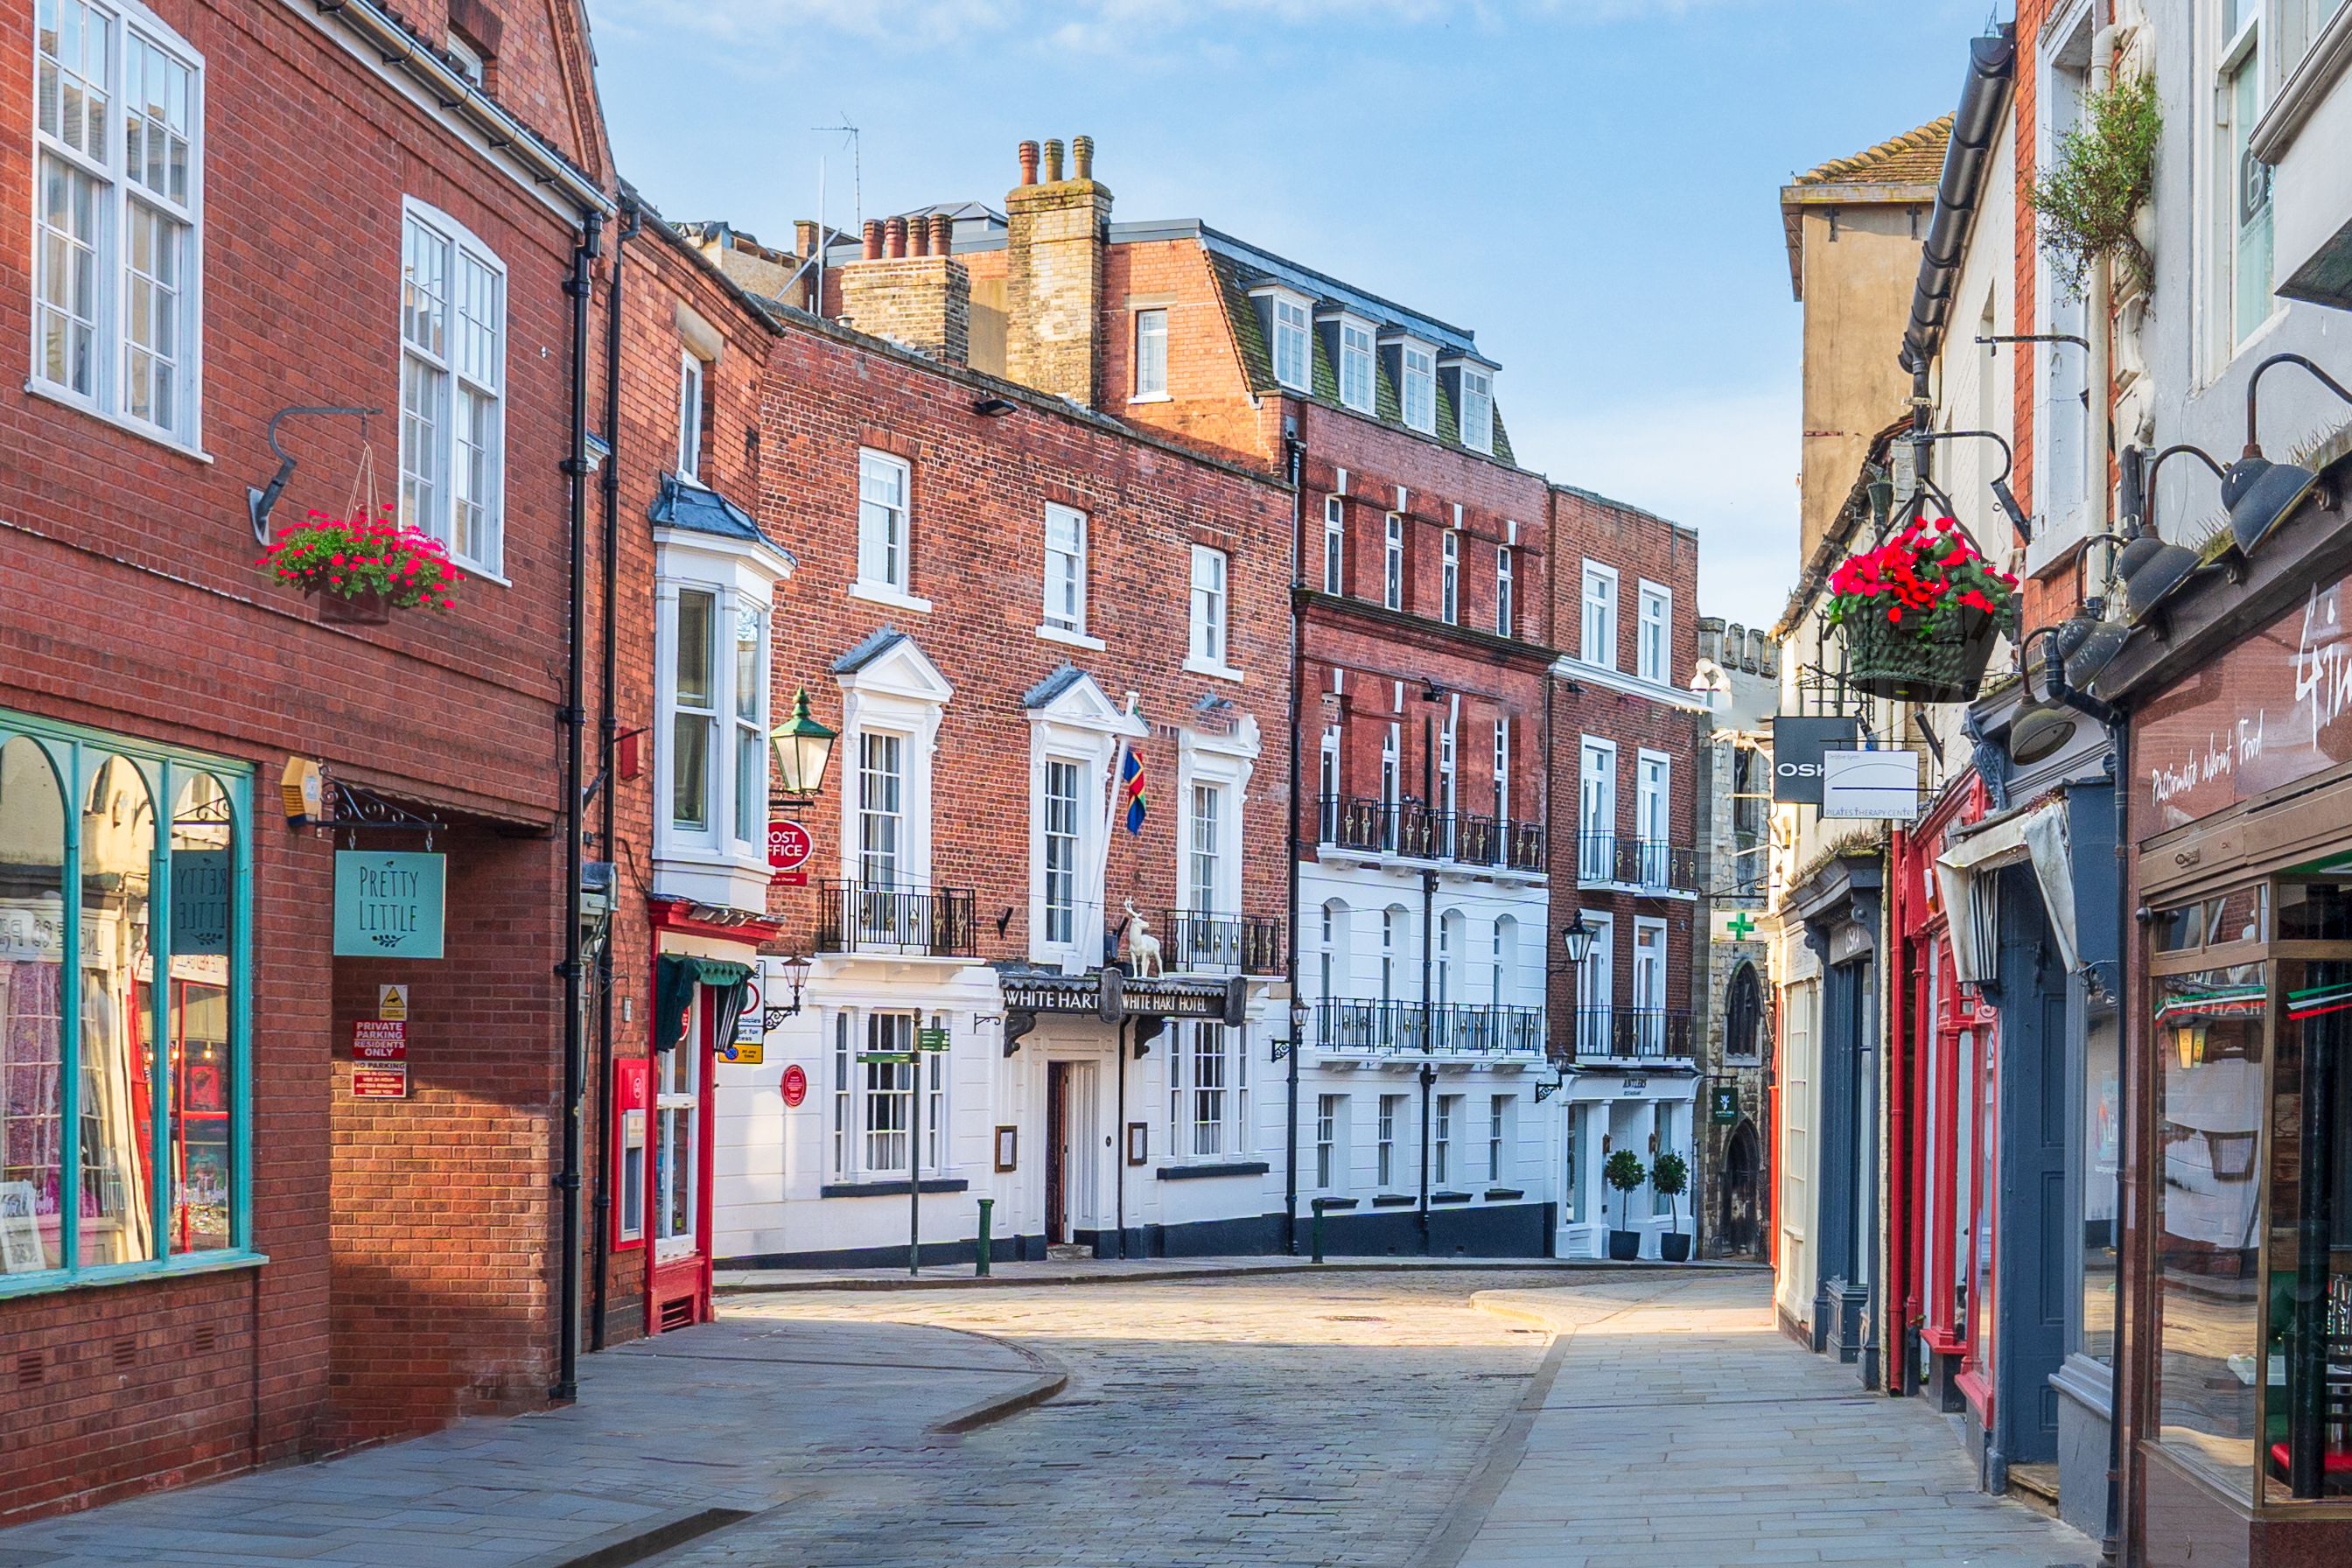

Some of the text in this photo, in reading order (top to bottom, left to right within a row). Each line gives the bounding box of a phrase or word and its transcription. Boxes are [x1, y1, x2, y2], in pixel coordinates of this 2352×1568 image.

[2152, 709, 2264, 807] Passionate about Food
[1826, 807, 1853, 816] PILATES
[769, 831, 798, 843] OST
[360, 866, 418, 898] PRETTY
[360, 900, 417, 932] LITTLE
[1005, 990, 1101, 1009] WHITE HART
[1122, 993, 1207, 1012] WHITE HART HOTEL
[356, 1022, 402, 1031] PRIVATE
[365, 1048, 394, 1057] ONLY
